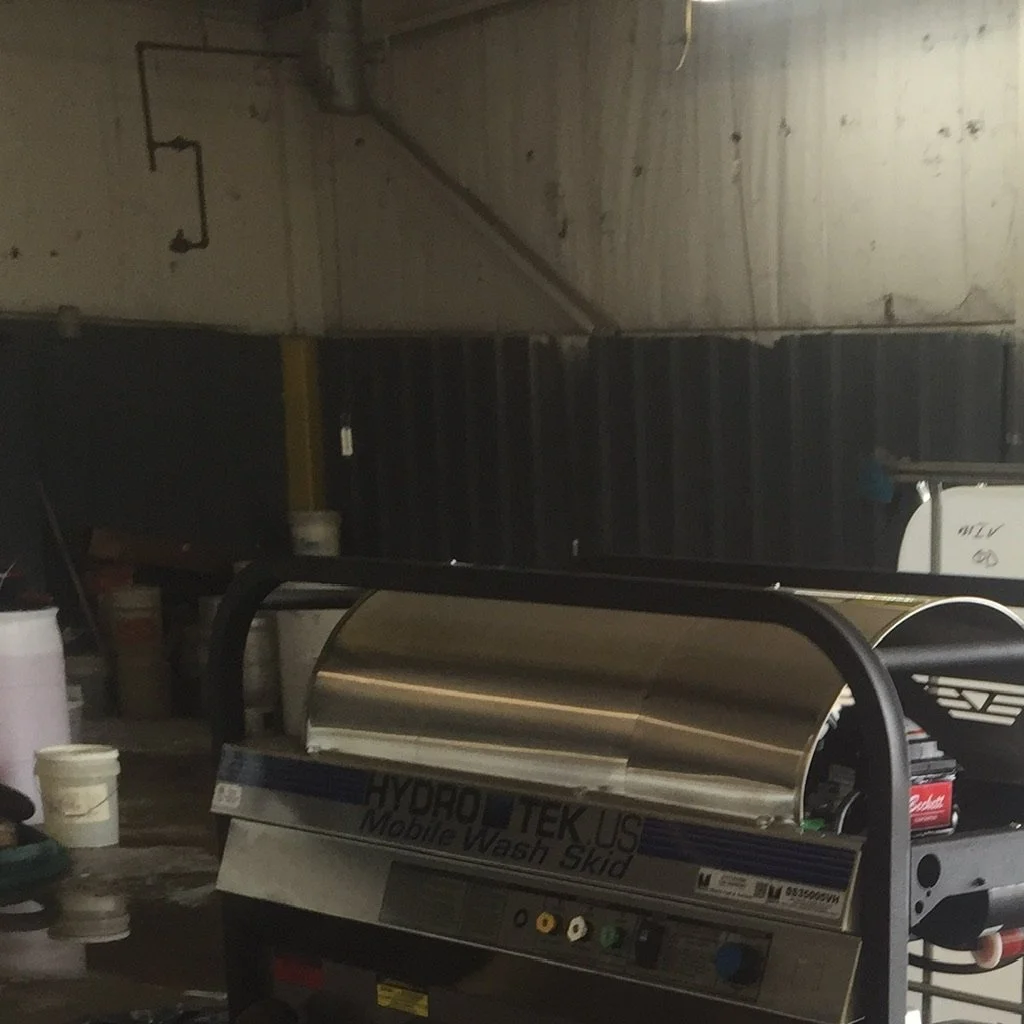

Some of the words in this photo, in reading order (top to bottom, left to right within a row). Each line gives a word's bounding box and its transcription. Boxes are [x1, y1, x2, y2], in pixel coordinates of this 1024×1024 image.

[364, 772, 481, 825] HYDRO
[359, 808, 456, 847] Mobile
[463, 827, 550, 865] Wash
[558, 843, 635, 881] Skid
